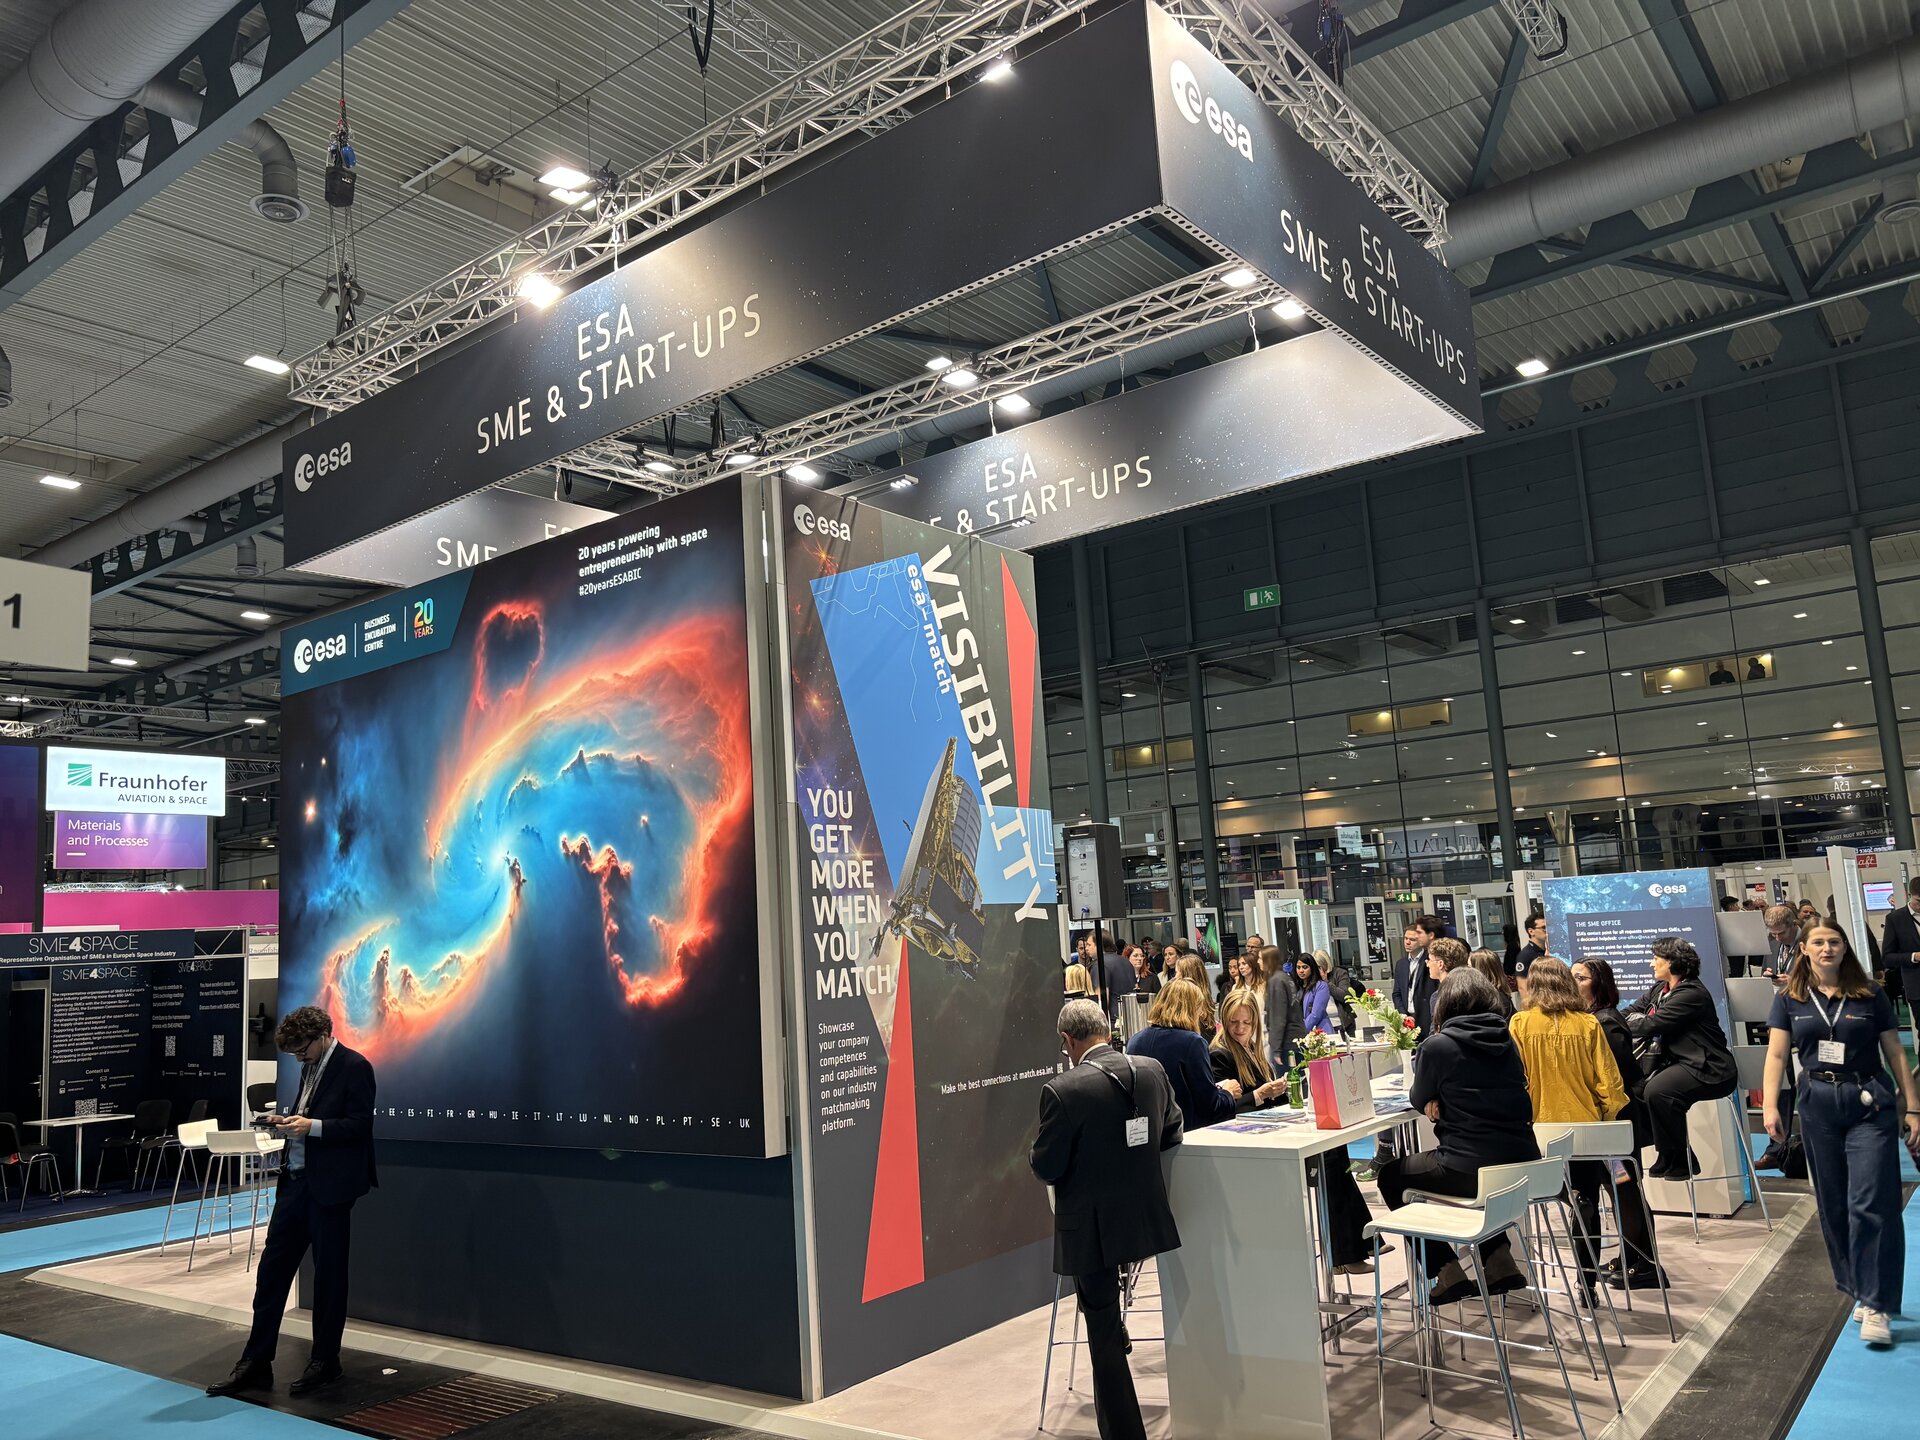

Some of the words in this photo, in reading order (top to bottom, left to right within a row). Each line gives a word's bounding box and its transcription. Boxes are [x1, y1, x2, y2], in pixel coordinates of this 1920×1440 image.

[1204, 90, 1254, 162] esa
[1360, 223, 1399, 289] ESA
[1279, 209, 1331, 285] SME
[1342, 258, 1358, 304] &
[1365, 275, 1467, 386] START-UPS
[577, 303, 634, 361] ESA
[477, 397, 532, 454] SME
[546, 386, 567, 424] &
[578, 293, 761, 410] START-UPS
[317, 441, 352, 479] esa
[984, 452, 1037, 493] ESA
[956, 509, 973, 534] &
[986, 455, 1152, 526] START-UPS
[817, 514, 852, 542] esa
[578, 547, 589, 561] 20
[591, 540, 616, 560] years
[618, 525, 660, 550] powering
[579, 546, 654, 578] entrepreneurship
[656, 538, 678, 553] with
[680, 527, 708, 547] space
[579, 567, 642, 597] #20yearsESABIC
[364, 614, 390, 630] BUSINESS
[414, 597, 434, 628] 20
[364, 624, 396, 641] INCUBATION
[414, 624, 434, 639] YEARS
[907, 564, 951, 695] esa-match
[315, 634, 347, 662] esa
[364, 639, 384, 653] CENTRE
[922, 544, 1049, 923] VISIBILITY
[99, 772, 208, 791] Fraunhofer
[118, 794, 166, 803] AVIATION
[168, 796, 176, 804] &
[178, 796, 208, 805] SPACE
[807, 787, 853, 819] YOU
[68, 819, 121, 831] Materials
[810, 823, 853, 854] GET
[67, 835, 90, 846] and
[94, 836, 149, 847] Processes
[812, 859, 874, 889] MORE
[1664, 884, 1687, 894] esa
[813, 894, 881, 926] WHEN
[1601, 919, 1621, 927] OFFICE
[29, 934, 139, 954] SME4SPACE
[113, 952, 136, 960] Europe's
[137, 951, 153, 959] Space
[154, 950, 177, 958] Industry
[814, 930, 860, 963] YOU
[62, 966, 137, 981] SME4SPACE
[816, 964, 892, 1000] MATCH
[819, 1022, 855, 1035] Showcase
[819, 1041, 835, 1053] your
[838, 1035, 869, 1048] company
[820, 1051, 867, 1067] competences
[820, 1071, 834, 1083] and
[837, 1065, 877, 1081] capabilities
[941, 1085, 956, 1095] Make
[958, 1082, 967, 1092] the
[968, 1079, 980, 1090] best
[982, 1074, 1011, 1087] connections
[1020, 1066, 1054, 1080] match.esa.int
[821, 1089, 830, 1100] on
[833, 1087, 845, 1097] our
[848, 1081, 877, 1094] industry
[283, 1106, 289, 1114] AT
[389, 1108, 395, 1116] EE
[407, 1108, 414, 1117] ES
[427, 1109, 434, 1118] FI
[446, 1109, 454, 1118] FR
[467, 1110, 475, 1118] GR
[489, 1110, 497, 1119] HU
[512, 1111, 519, 1120] IE
[533, 1111, 541, 1121] IT
[556, 1112, 563, 1121] LT
[579, 1113, 587, 1122] LU
[603, 1114, 612, 1123] NL
[629, 1115, 638, 1124] NO
[656, 1116, 665, 1126] PL
[683, 1116, 692, 1126] PT
[711, 1117, 720, 1127] SE
[740, 1118, 750, 1128] UK
[821, 1098, 870, 1116] matchmaking
[822, 1117, 856, 1135] platform.
